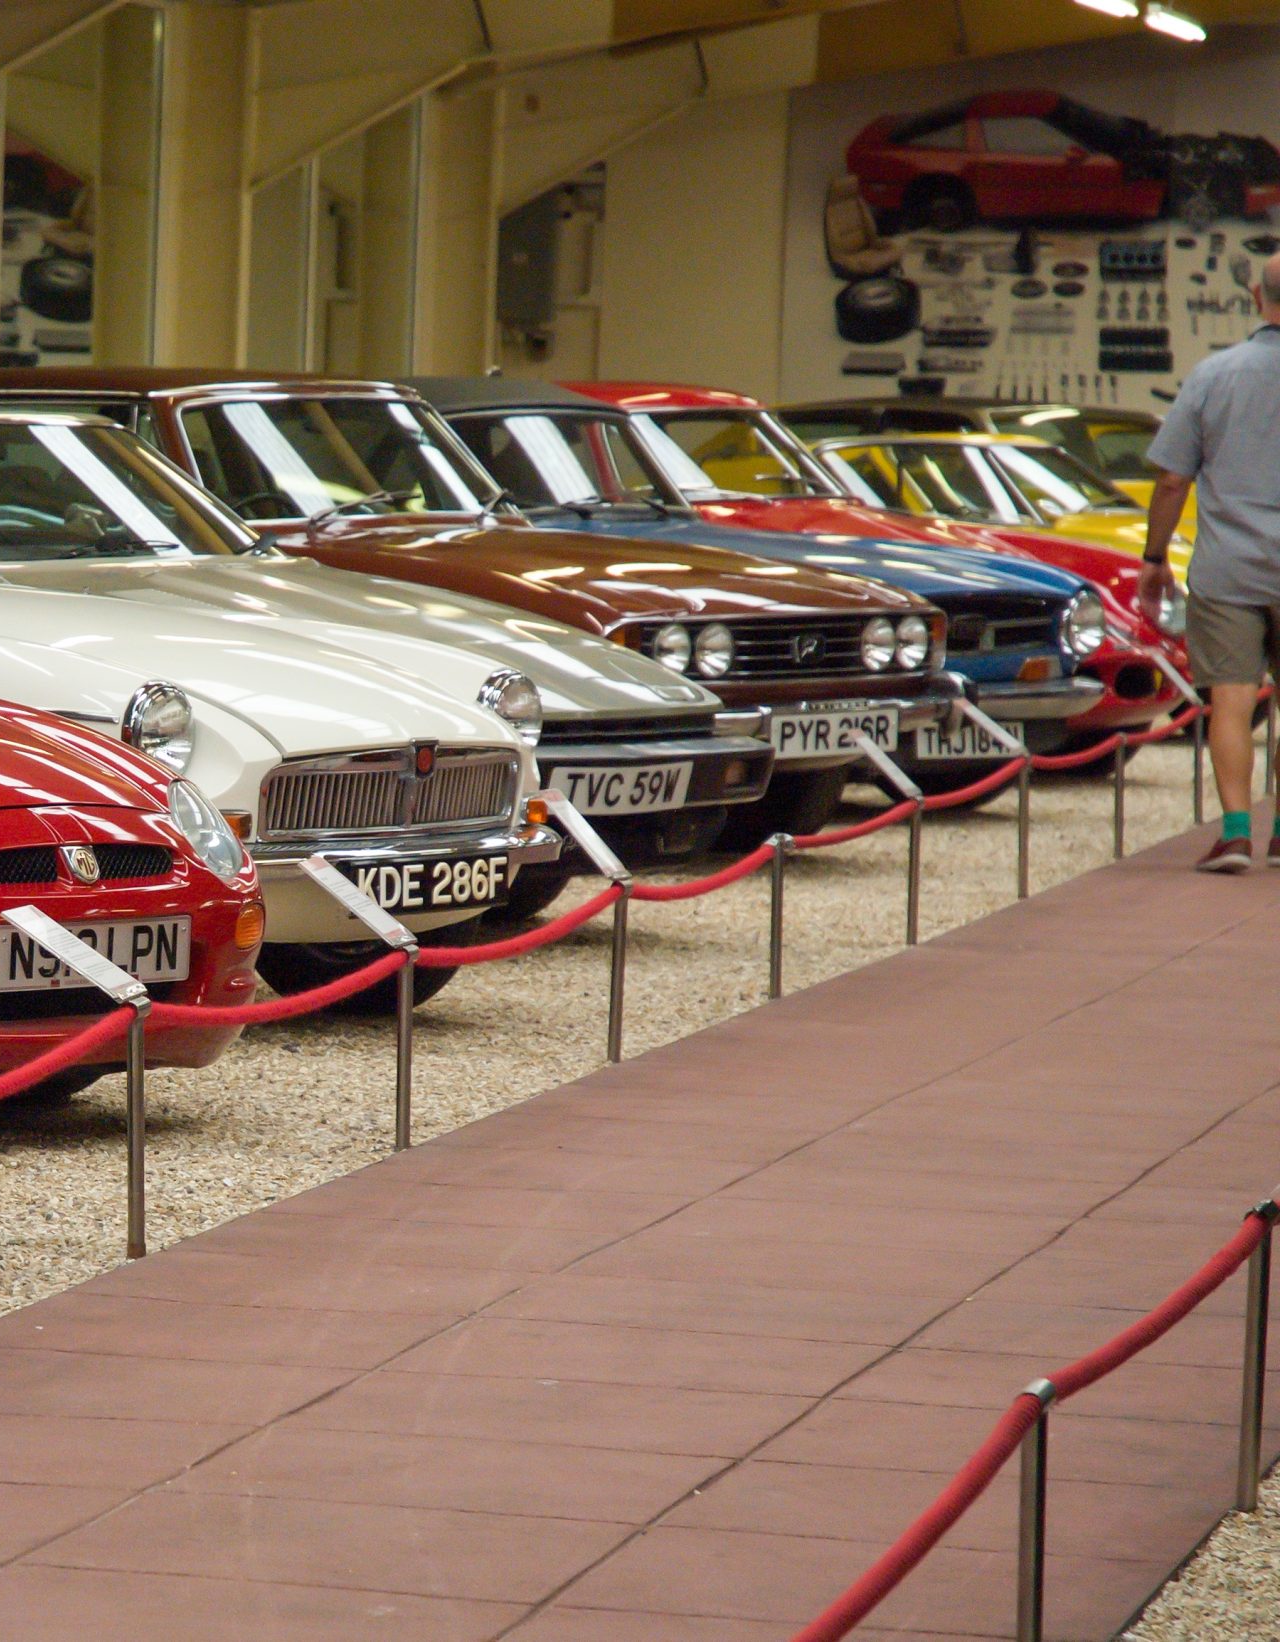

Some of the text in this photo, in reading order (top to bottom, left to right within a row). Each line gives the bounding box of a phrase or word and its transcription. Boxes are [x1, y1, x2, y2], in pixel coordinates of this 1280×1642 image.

[780, 719, 831, 753] PYR
[567, 768, 682, 808] TVC 59W
[357, 864, 424, 909] KDE
[431, 856, 508, 905] 286F
[107, 923, 178, 973] LPN
